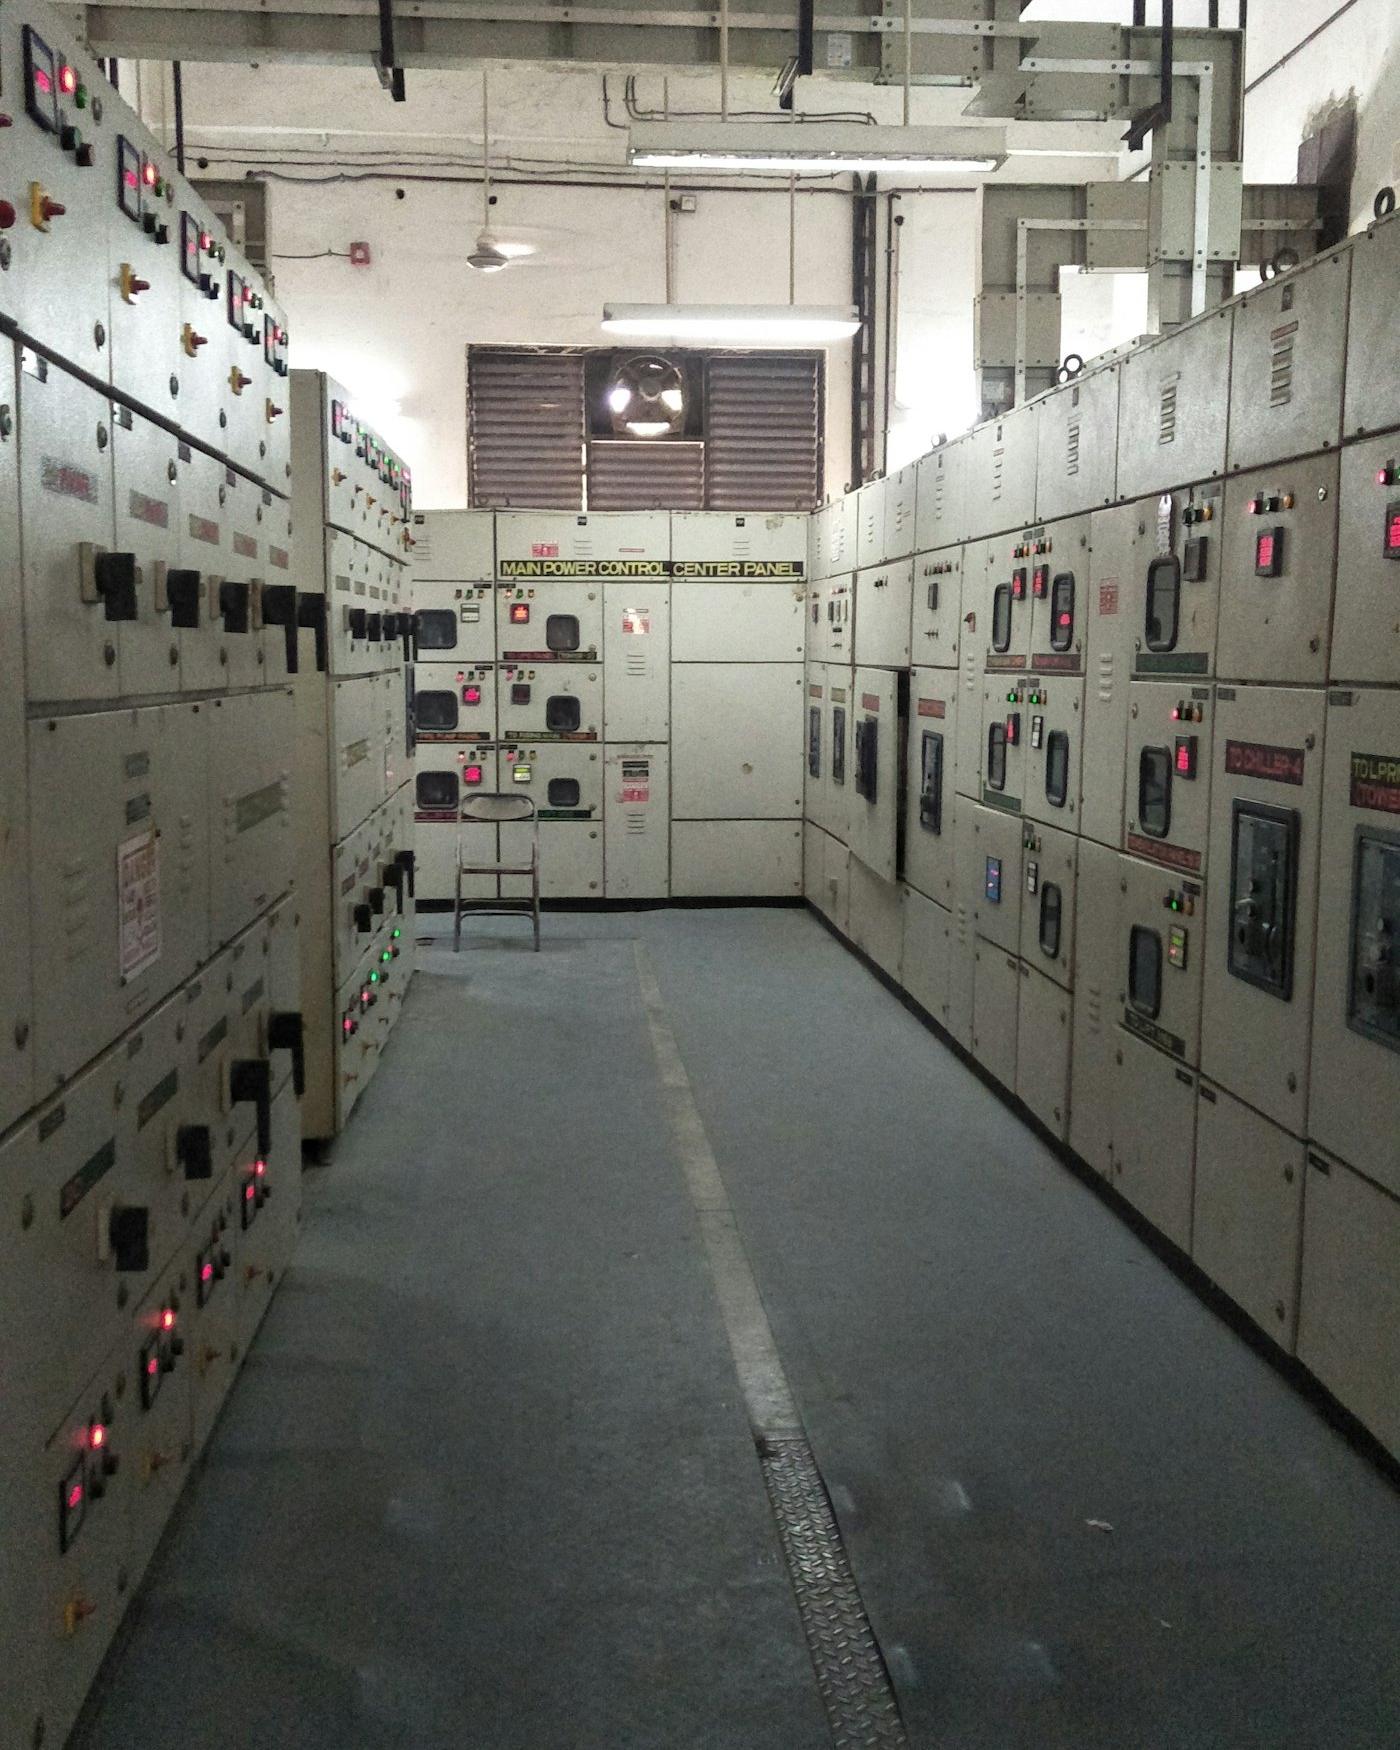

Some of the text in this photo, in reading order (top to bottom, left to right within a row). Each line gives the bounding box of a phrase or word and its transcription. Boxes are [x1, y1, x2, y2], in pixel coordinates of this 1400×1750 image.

[503, 562, 801, 576] MAIN POWER CONTROL CENTER PANEL
